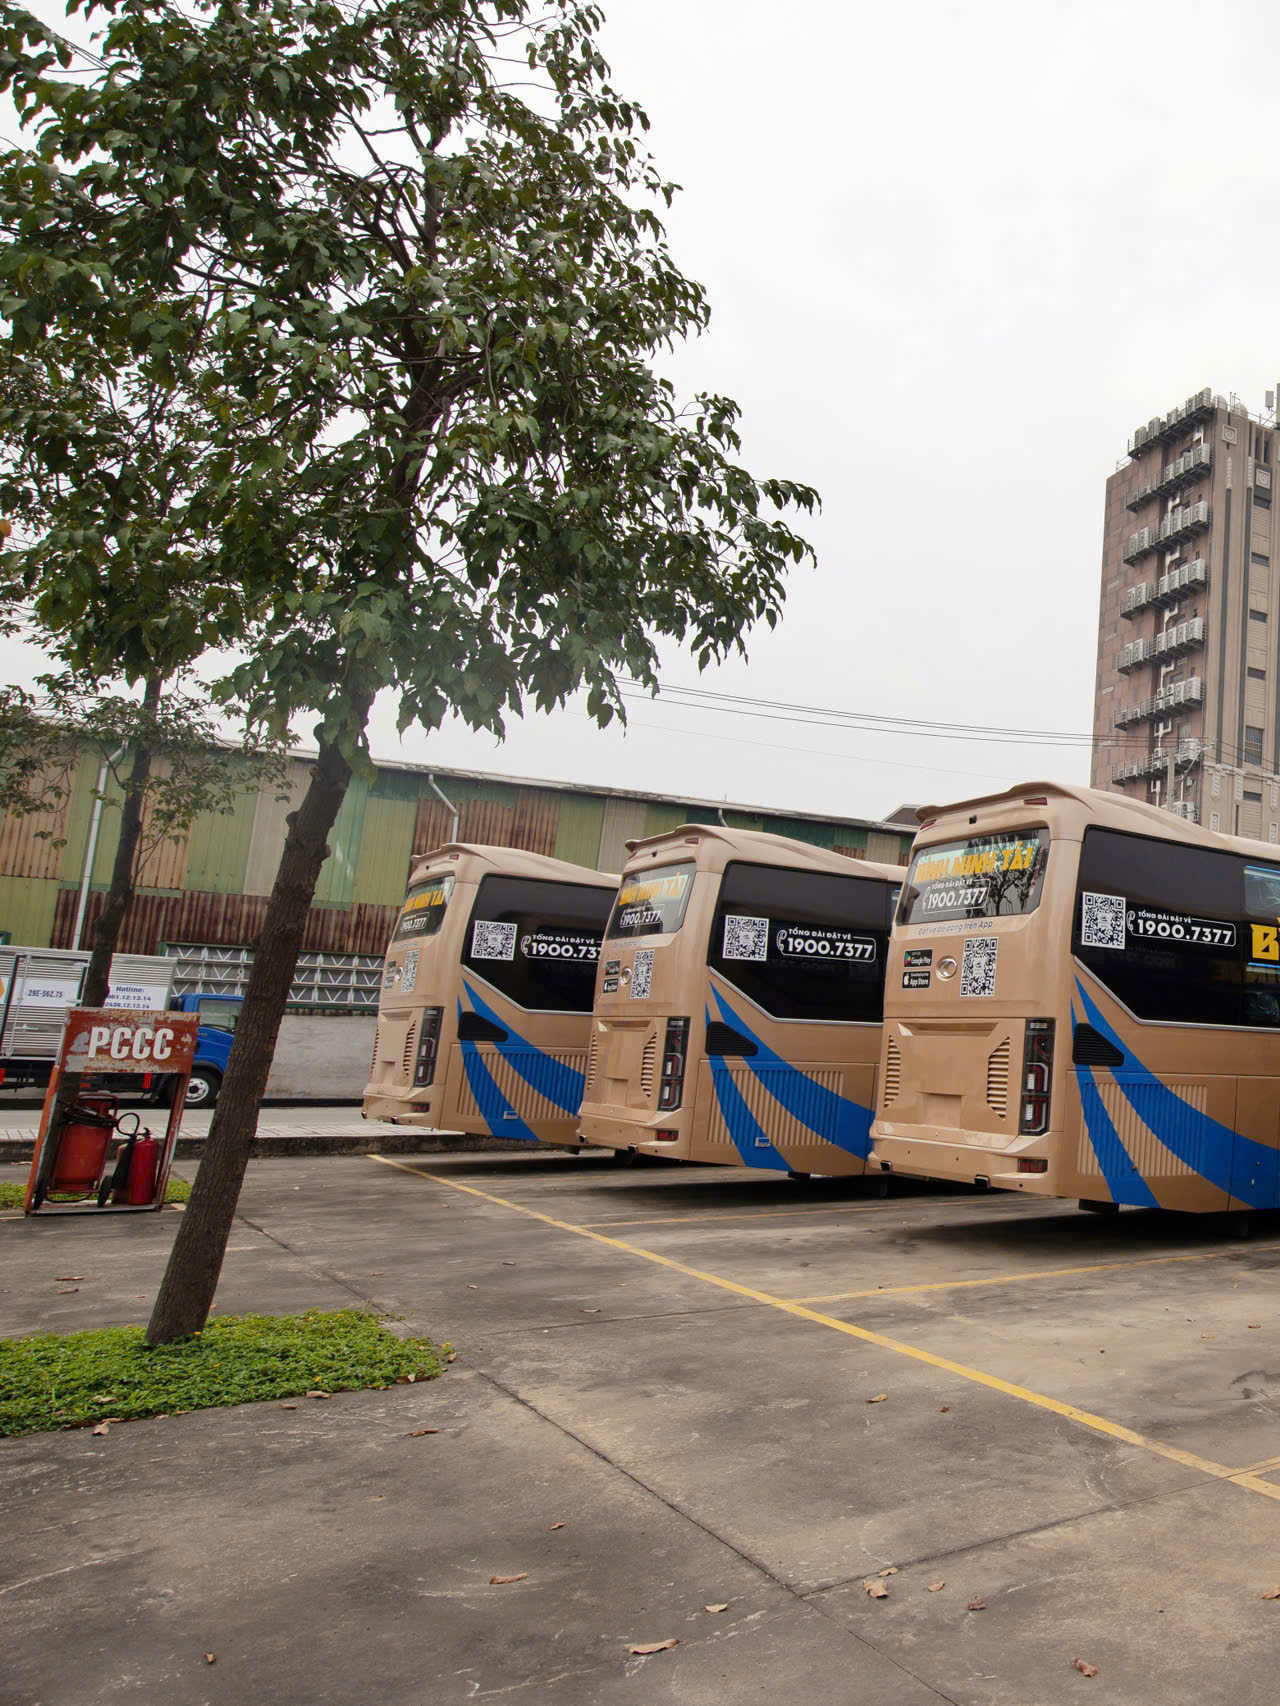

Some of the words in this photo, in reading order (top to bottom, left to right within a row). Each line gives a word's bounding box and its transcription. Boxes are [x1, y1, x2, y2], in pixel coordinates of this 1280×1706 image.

[928, 887, 988, 909] 1900.7377
[623, 910, 662, 925] 1900.7377
[1138, 909, 1157, 920] TỔNG
[788, 926, 810, 936] TỔNG
[1137, 919, 1233, 944] 1900.7377
[531, 942, 601, 959] 1900.73
[788, 937, 873, 958] 1900.7377
[910, 978, 918, 987] App
[88, 1027, 174, 1060] PCCC
